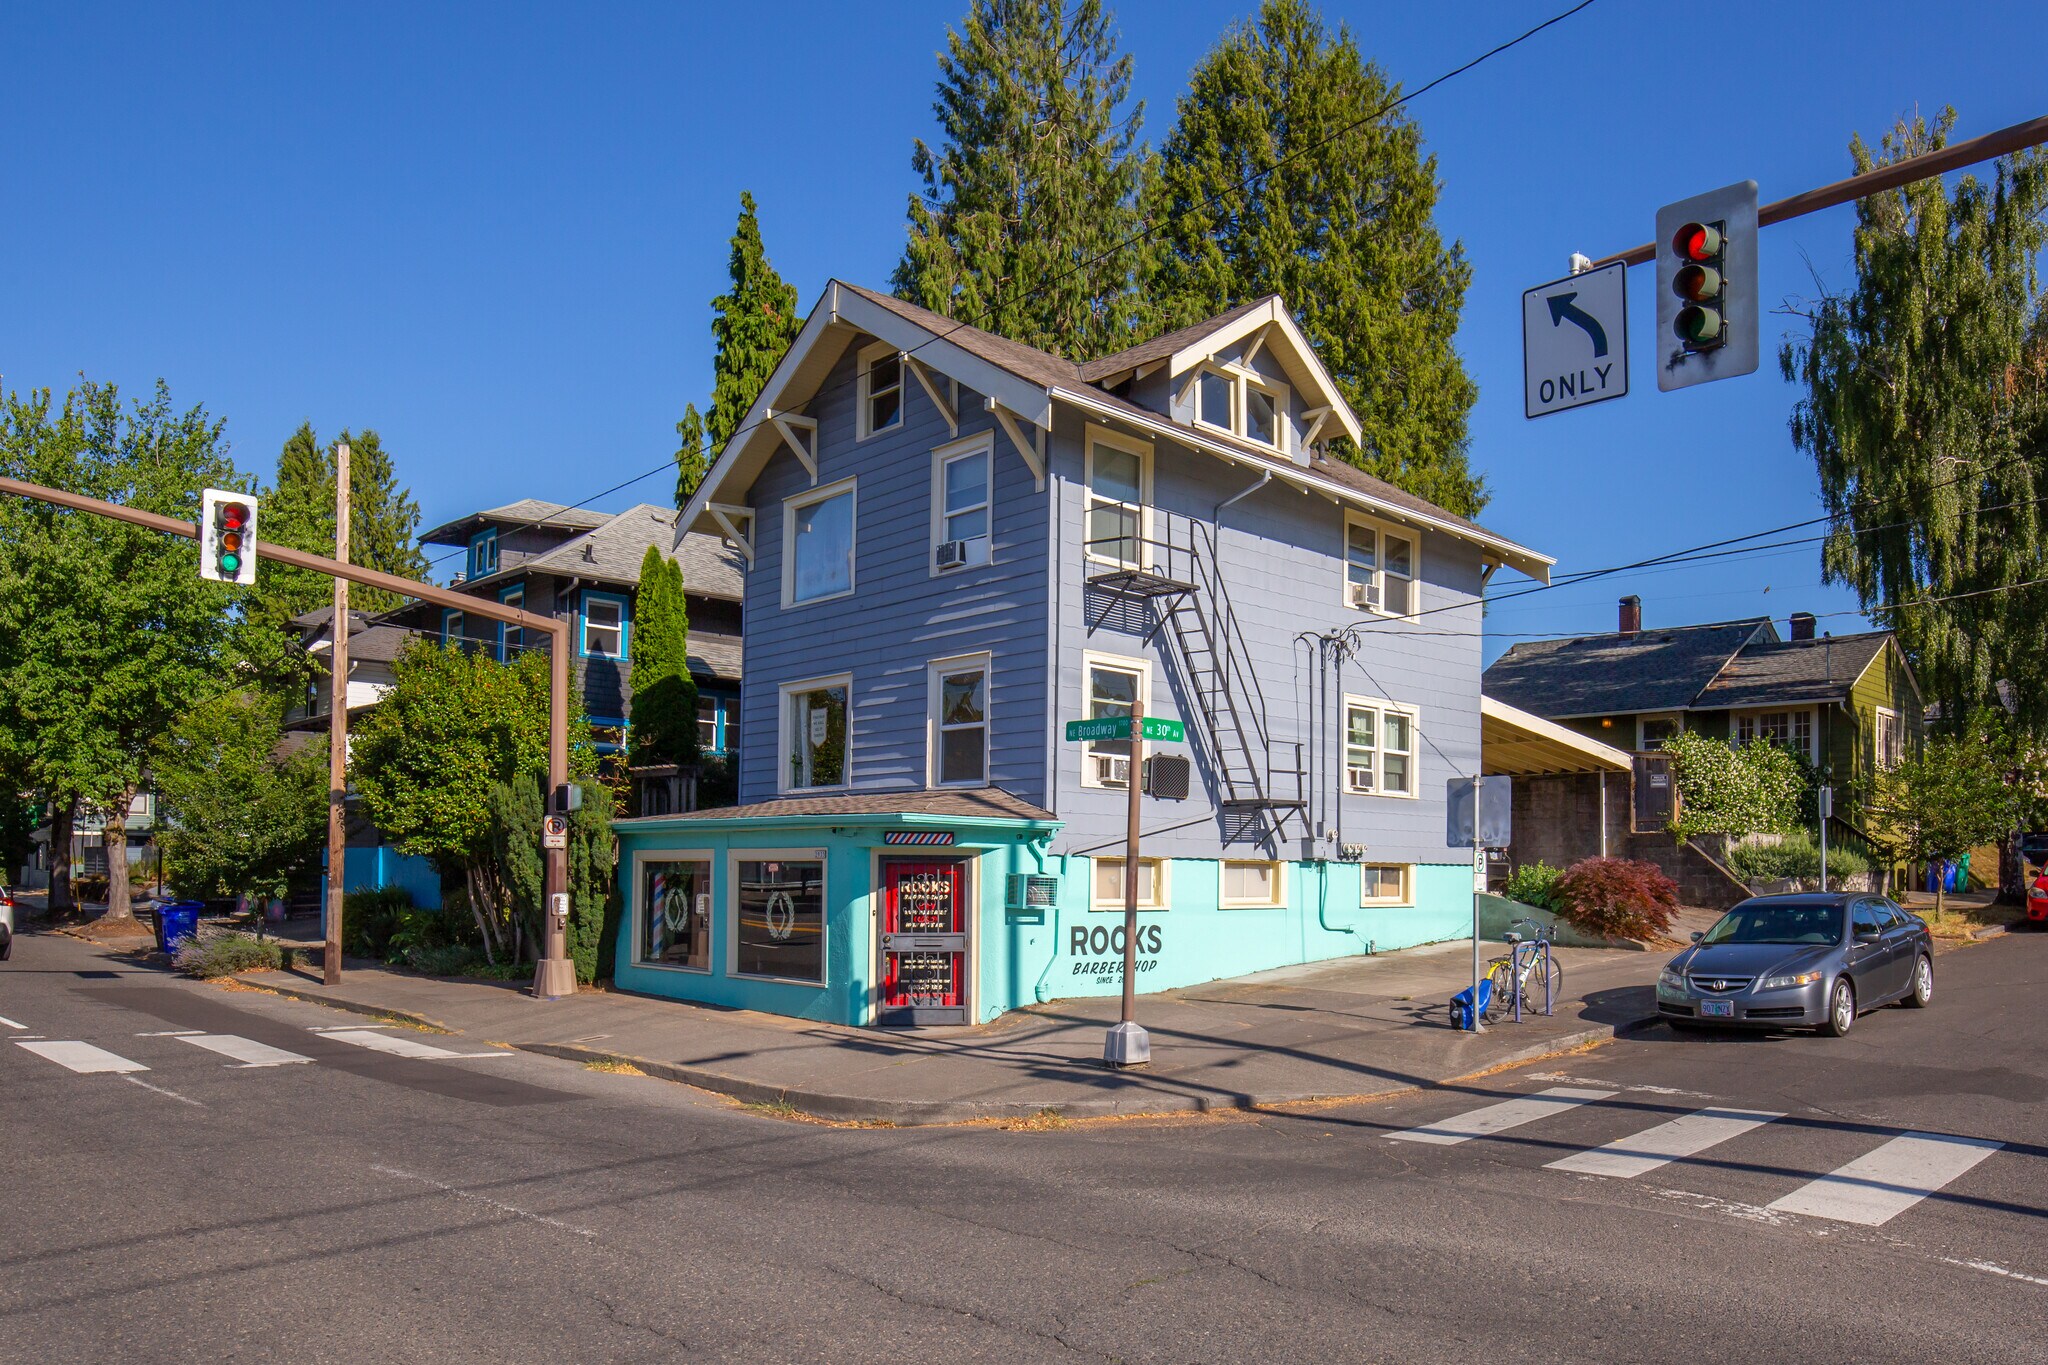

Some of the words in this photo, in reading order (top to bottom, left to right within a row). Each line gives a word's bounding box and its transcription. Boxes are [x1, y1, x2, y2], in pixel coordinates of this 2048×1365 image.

[1540, 363, 1613, 404] ONLY
[1078, 723, 1117, 737] Broadway
[1146, 726, 1153, 734] NE
[1072, 960, 1157, 975] BARBERHOP
[1096, 976, 1113, 984] SINCE
